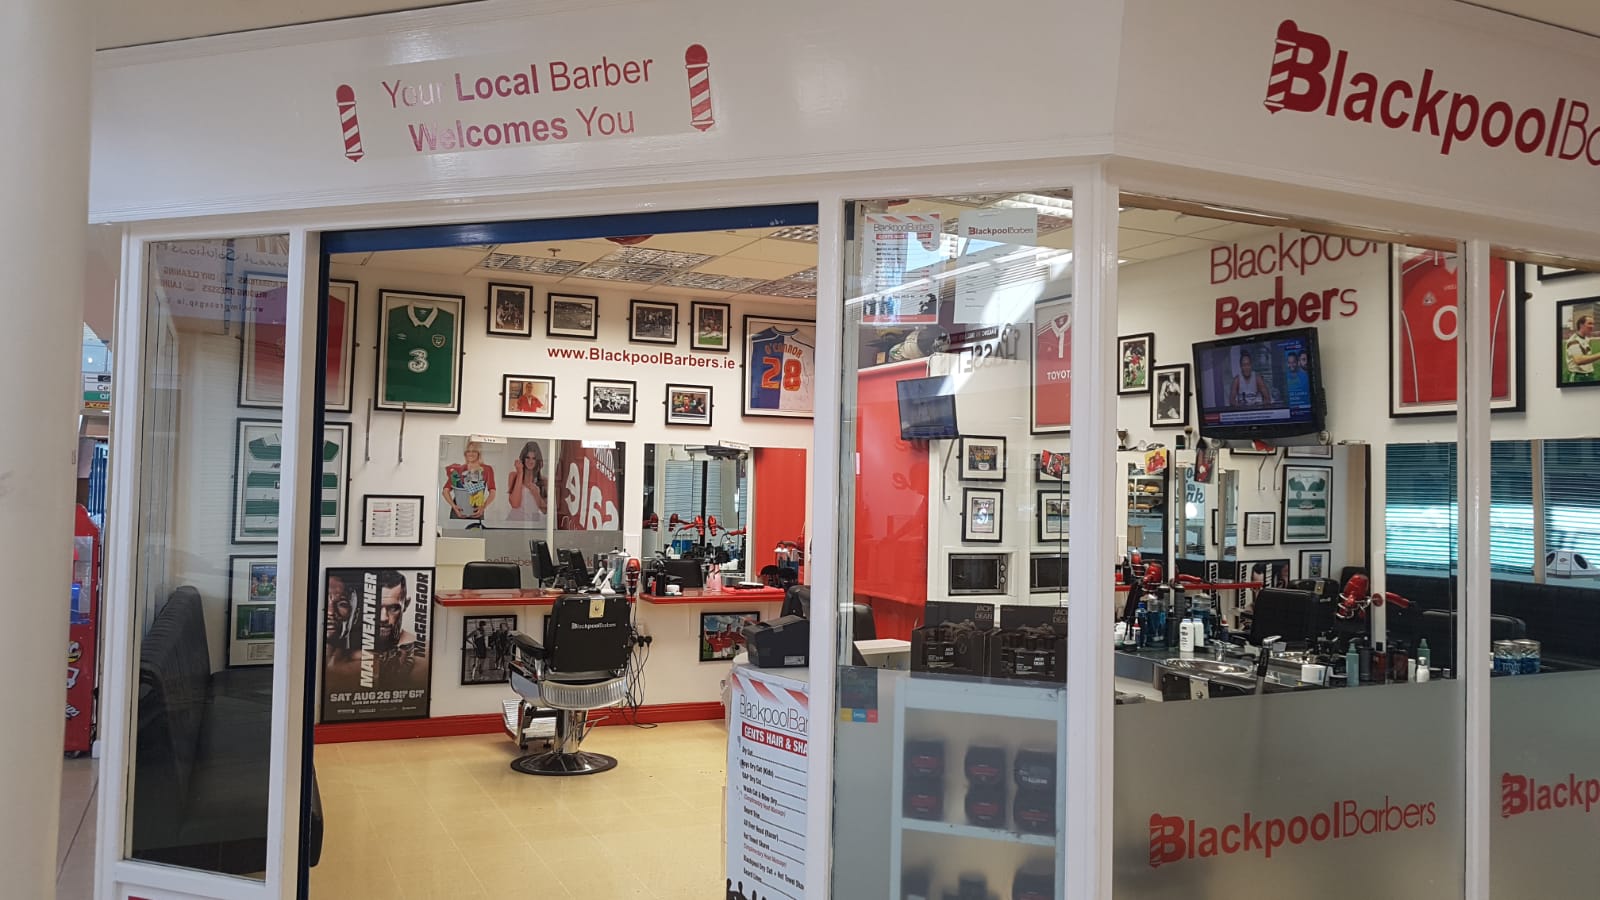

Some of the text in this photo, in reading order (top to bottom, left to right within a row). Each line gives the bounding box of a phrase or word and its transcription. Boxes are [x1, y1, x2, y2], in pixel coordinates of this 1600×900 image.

[381, 56, 654, 109] Your Local Barber
[409, 106, 635, 153] Welcomes You
[968, 226, 1034, 236] BlackpoolBarbers
[1215, 275, 1358, 336] Barbers
[408, 349, 429, 373] 3
[547, 347, 736, 370] www.BlackpoolBarbers.ie
[762, 356, 802, 391] 28
[360, 572, 377, 688] MAYWEATHER
[413, 572, 429, 659] McGREGOR
[330, 692, 352, 702] SAT
[353, 691, 376, 701] AUG
[377, 690, 391, 700] 26
[744, 725, 765, 742] GENTS
[766, 731, 784, 748] HAIR
[785, 738, 791, 750] &
[1149, 795, 1437, 868] BlackpoolBarbers
